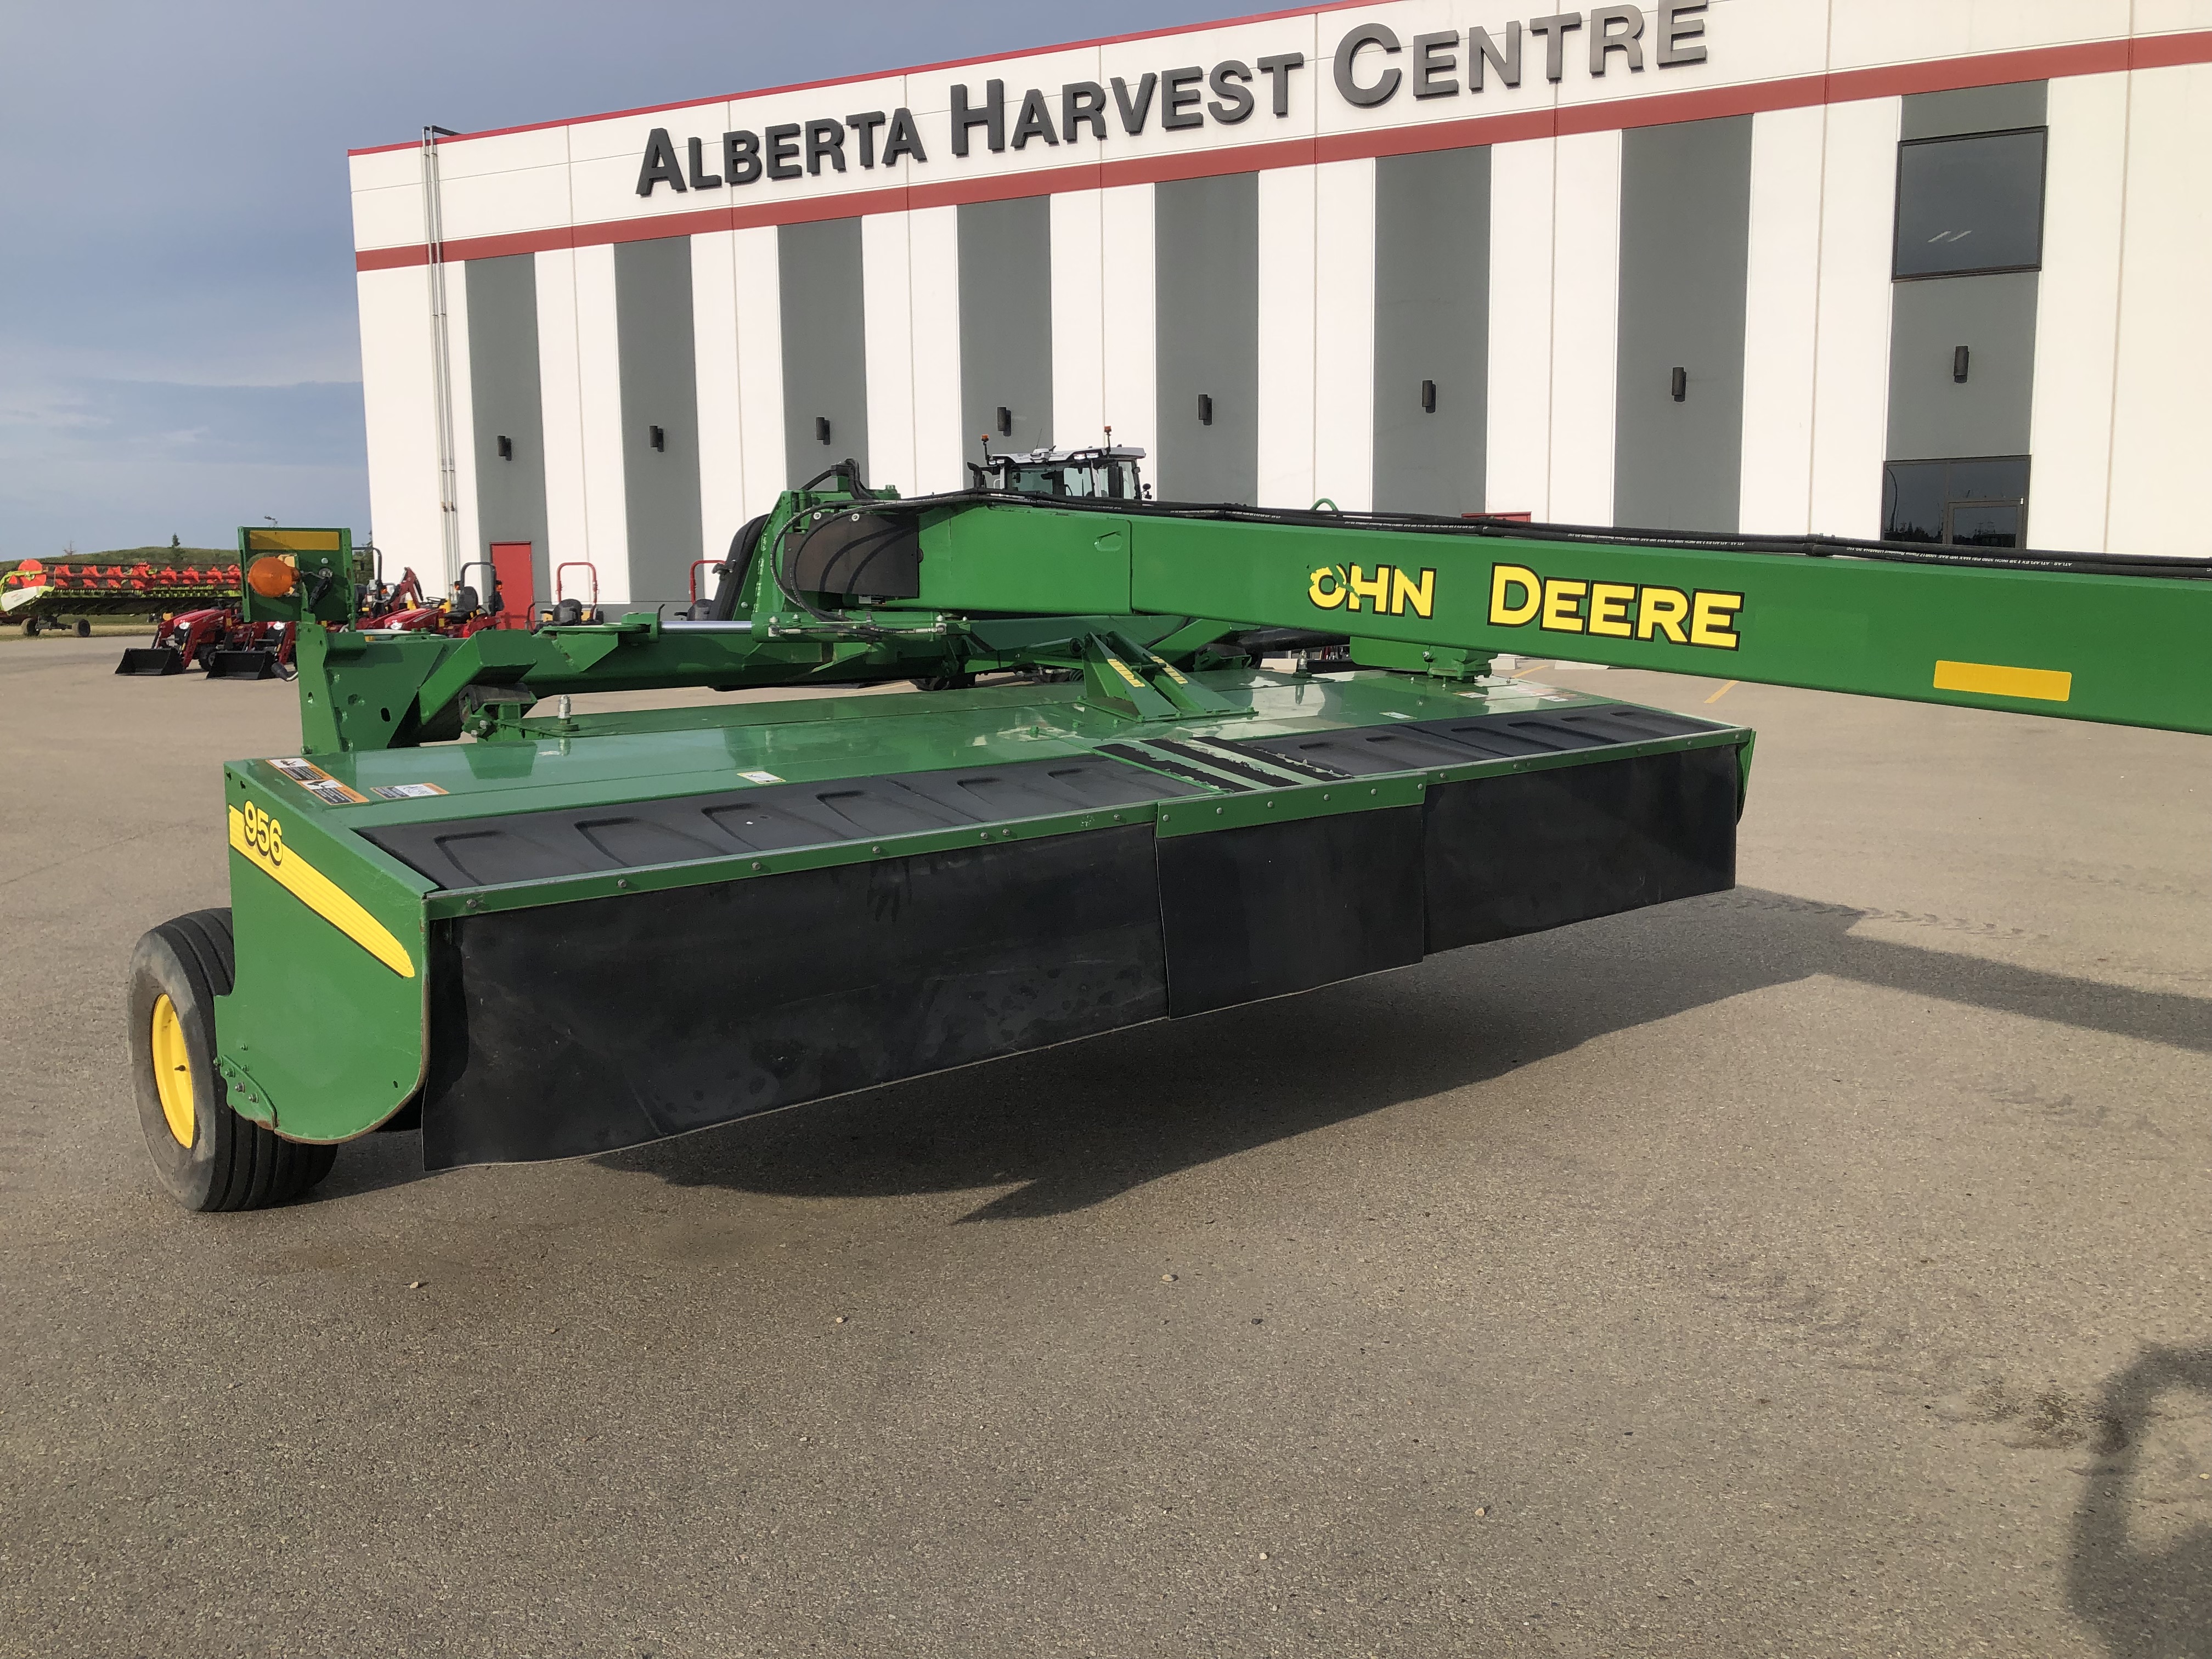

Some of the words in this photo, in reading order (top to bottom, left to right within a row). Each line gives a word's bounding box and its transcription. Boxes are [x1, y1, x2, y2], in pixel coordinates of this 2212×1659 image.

[635, 108, 927, 196] ALBERTA
[950, 52, 1304, 158] HARVEST
[1333, 0, 1708, 109] CENTRE
[1487, 562, 1745, 651] DEERE
[244, 799, 283, 867] 956
